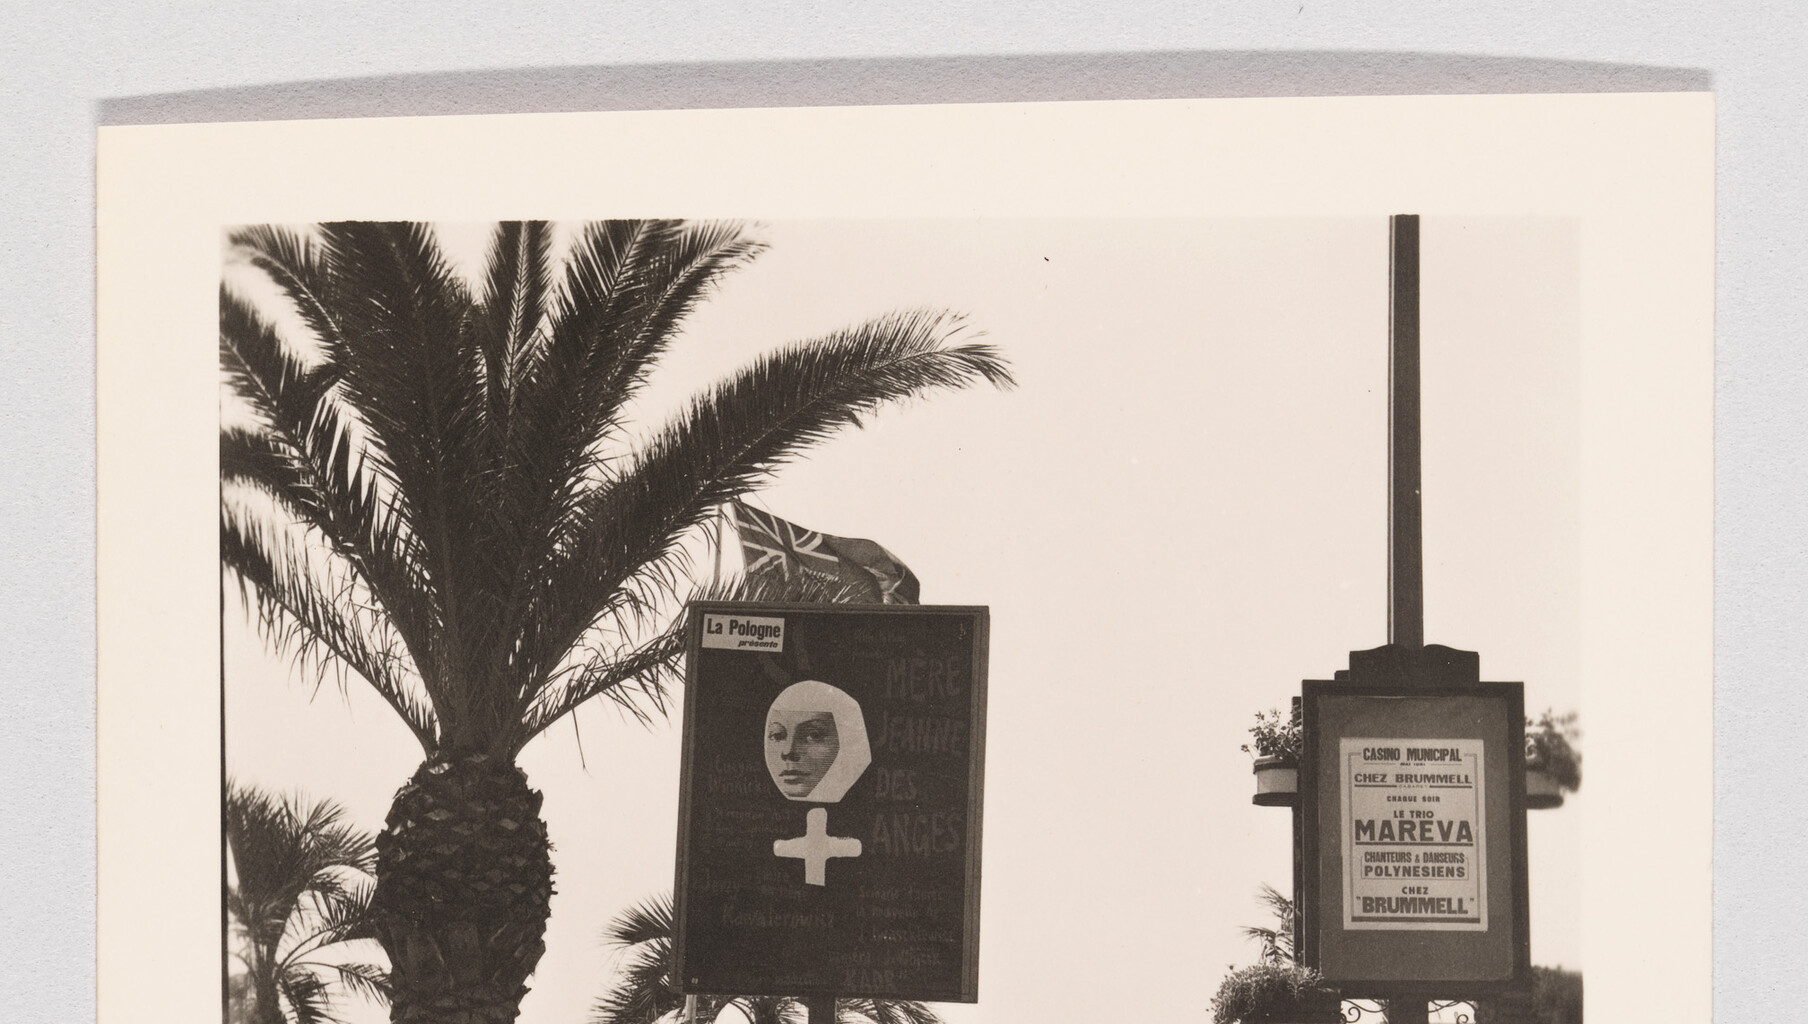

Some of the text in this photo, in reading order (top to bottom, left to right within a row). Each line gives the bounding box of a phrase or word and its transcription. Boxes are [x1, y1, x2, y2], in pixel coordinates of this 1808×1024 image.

[706, 618, 781, 641] La Pologne
[883, 647, 961, 702] MÈRE
[1363, 747, 1462, 762] CASINO MUNICIPAL
[874, 766, 918, 801] DES
[1354, 773, 1472, 784] CHEZ BRUMMELL
[1386, 795, 1440, 803] CHAQUE SOIR
[1393, 810, 1434, 819] LE TRIO
[870, 811, 963, 858] ANGES
[1354, 819, 1473, 842] MAREVA
[1364, 851, 1465, 864] CHANTEURS & DANSEURS
[1364, 865, 1466, 878] POLYNESIENS
[1402, 886, 1429, 895] CHEZ
[1356, 896, 1474, 914] "BRUMMELL"
